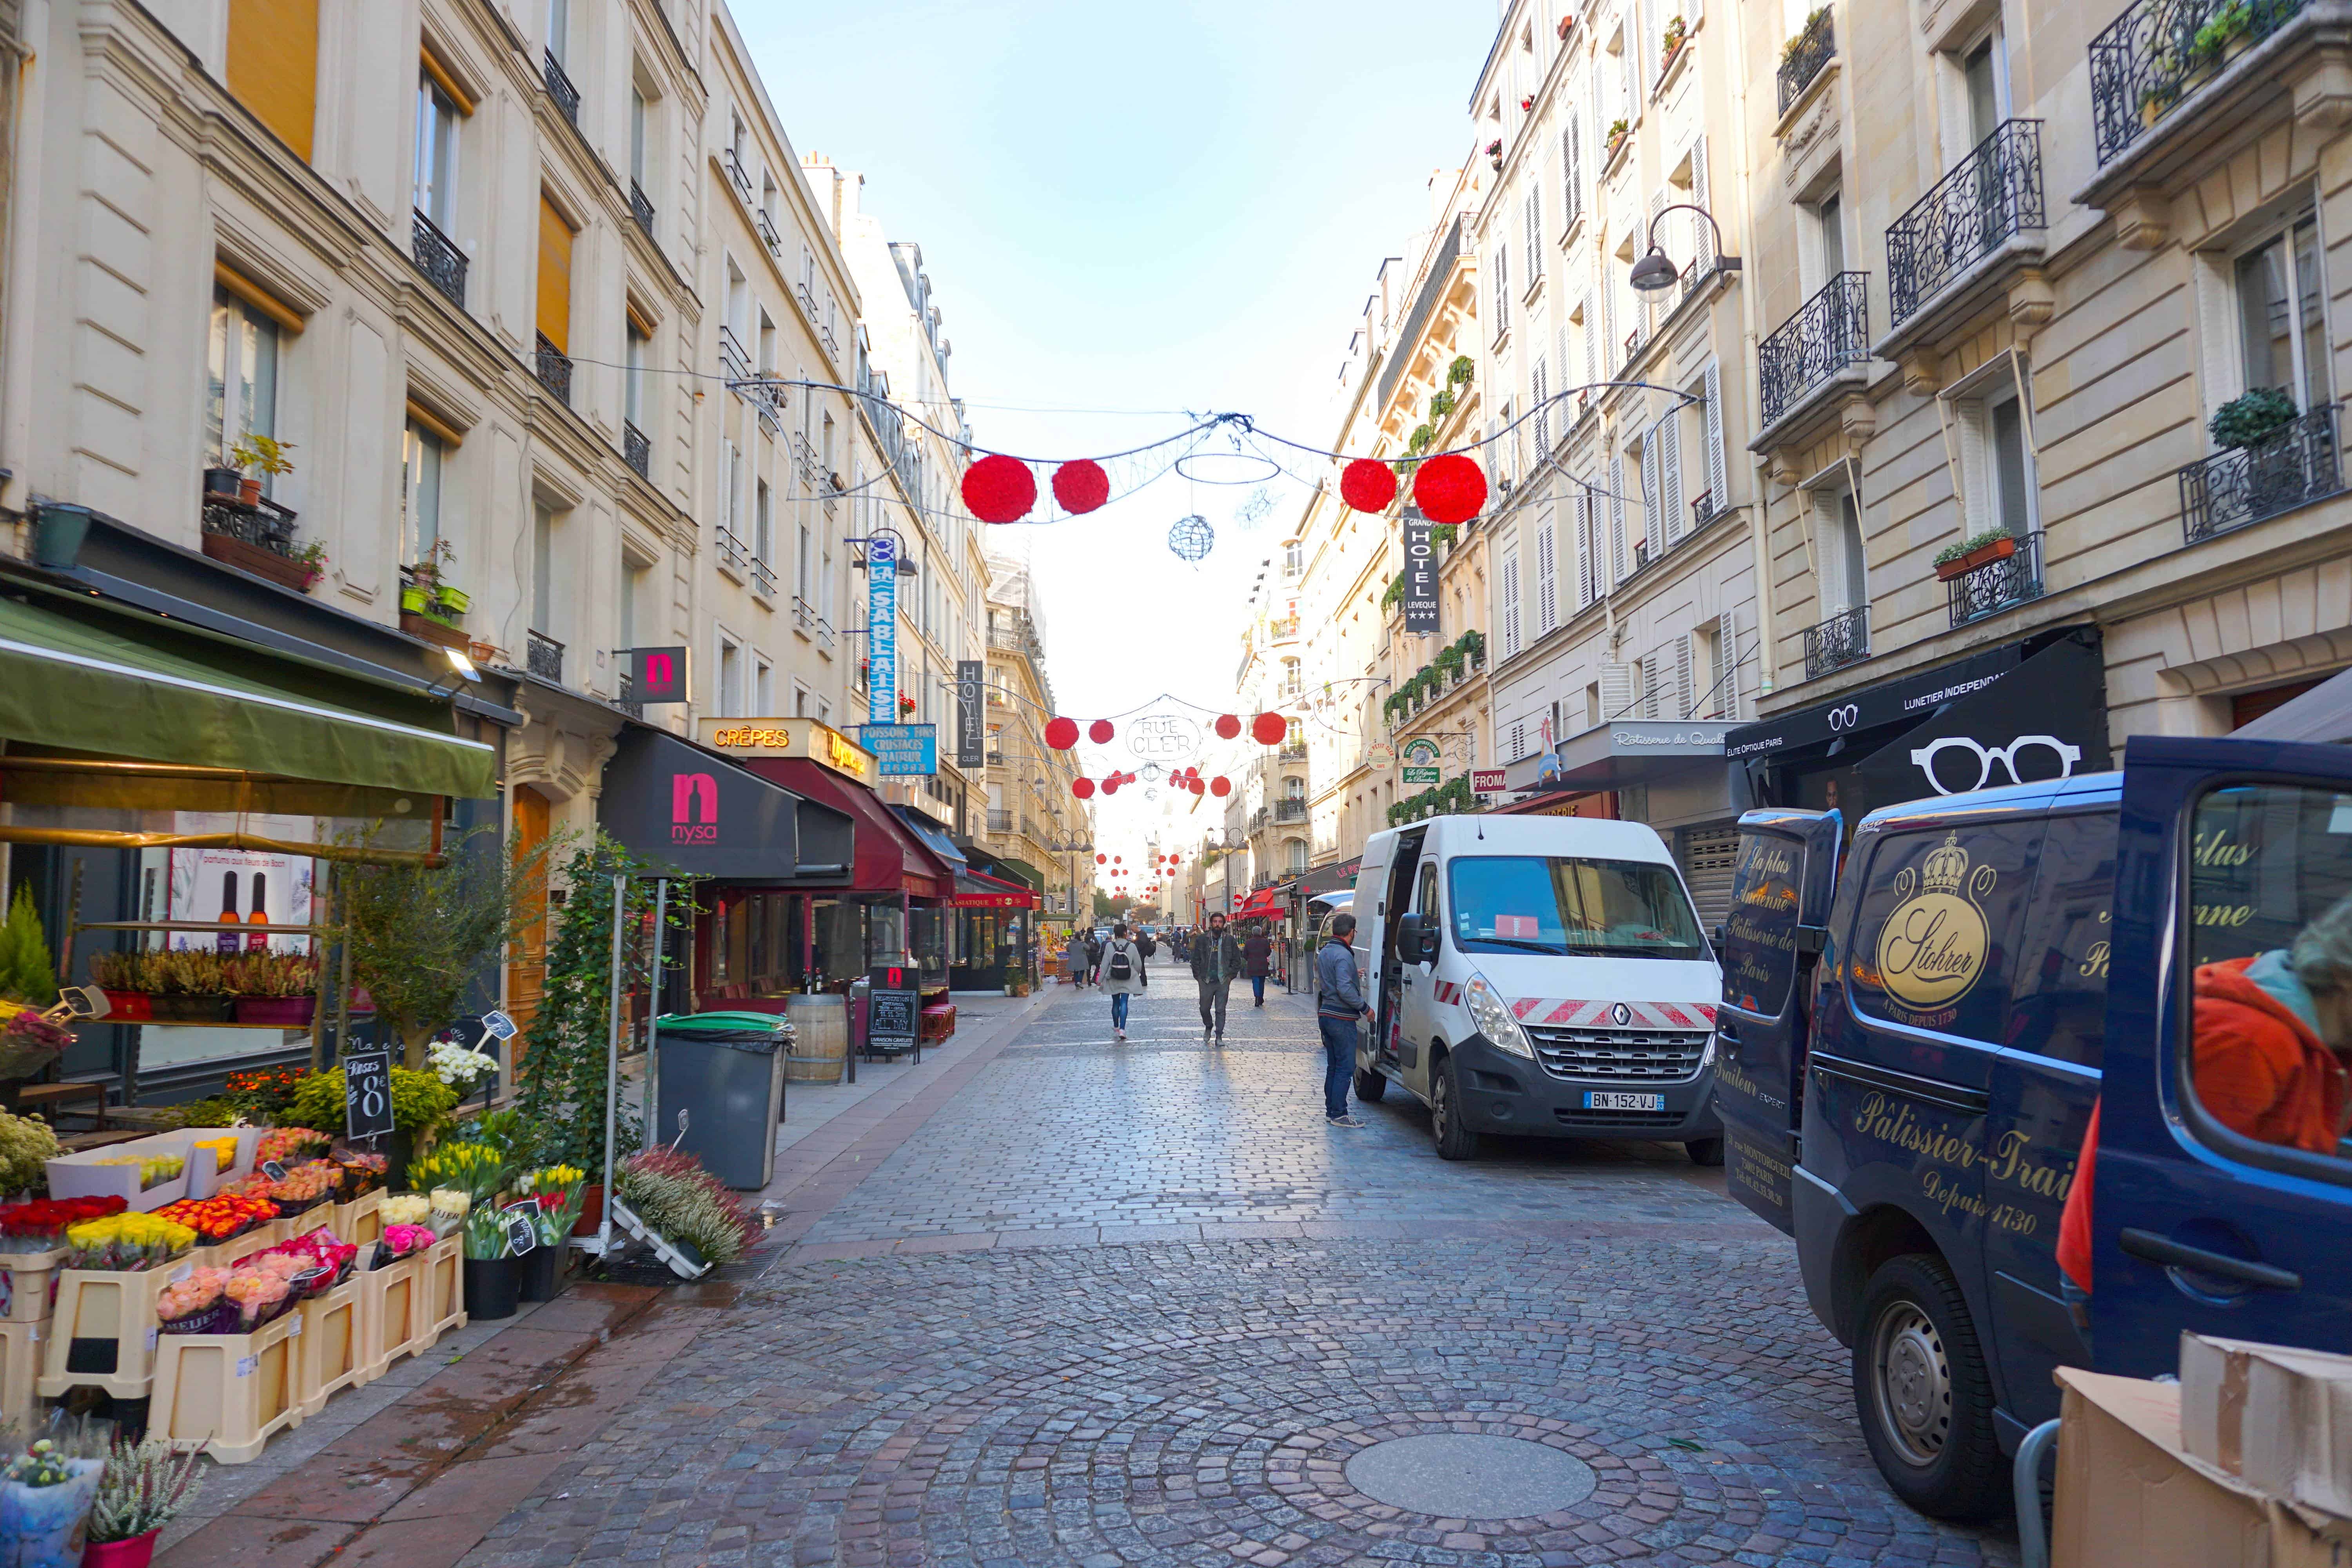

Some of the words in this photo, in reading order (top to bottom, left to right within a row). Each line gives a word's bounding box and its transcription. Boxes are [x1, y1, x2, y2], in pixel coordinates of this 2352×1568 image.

[870, 566, 894, 580] LA
[1410, 531, 1431, 596] HOTEL
[872, 592, 892, 721] SABLAISE
[963, 666, 976, 749] HOTEL
[1904, 690, 1943, 710] LUNETIER
[714, 726, 789, 748] CRÊPES
[863, 727, 909, 738] POISSONS
[914, 726, 936, 737] FINS
[1142, 720, 1178, 734] RUE
[1134, 735, 1191, 753] CLER
[1613, 731, 1671, 746] Rôtisserie
[1674, 733, 1687, 744] de
[1690, 731, 1725, 746] Quali
[1727, 746, 1741, 757] ELITE
[1741, 741, 1765, 753] OPTIQUE
[1765, 737, 1782, 748] PARIS
[1385, 746, 1394, 757] CLER
[672, 826, 717, 845] nysa
[1336, 867, 1347, 879] LE
[1748, 846, 1764, 870] La
[1760, 850, 1793, 880] plus
[1735, 880, 1789, 912] Ancienne
[1728, 913, 1778, 947] Pâtisserie
[1779, 927, 1795, 952] de
[1886, 908, 1974, 975] Stohrer
[1740, 953, 1772, 982] Paris
[874, 1019, 891, 1029] ALL
[893, 1020, 908, 1030] DAY
[1887, 1004, 1909, 1024] PARIS
[1908, 1013, 1936, 1027] DEPUIS
[1938, 1008, 1958, 1025] 1730
[1714, 1054, 1757, 1097] Traiteur
[1759, 1092, 1786, 1110] EXPERT
[1594, 1094, 1655, 1109] BN-152-VJ
[1856, 1091, 2076, 1202] Pâtissier-Trai
[1734, 1141, 1744, 1154] rue
[1744, 1141, 1792, 1180] MONTORGUEIL
[1756, 1166, 1775, 1186] PARIS
[1923, 1171, 1994, 1216] Depuis
[1991, 1203, 2037, 1235] 1730
